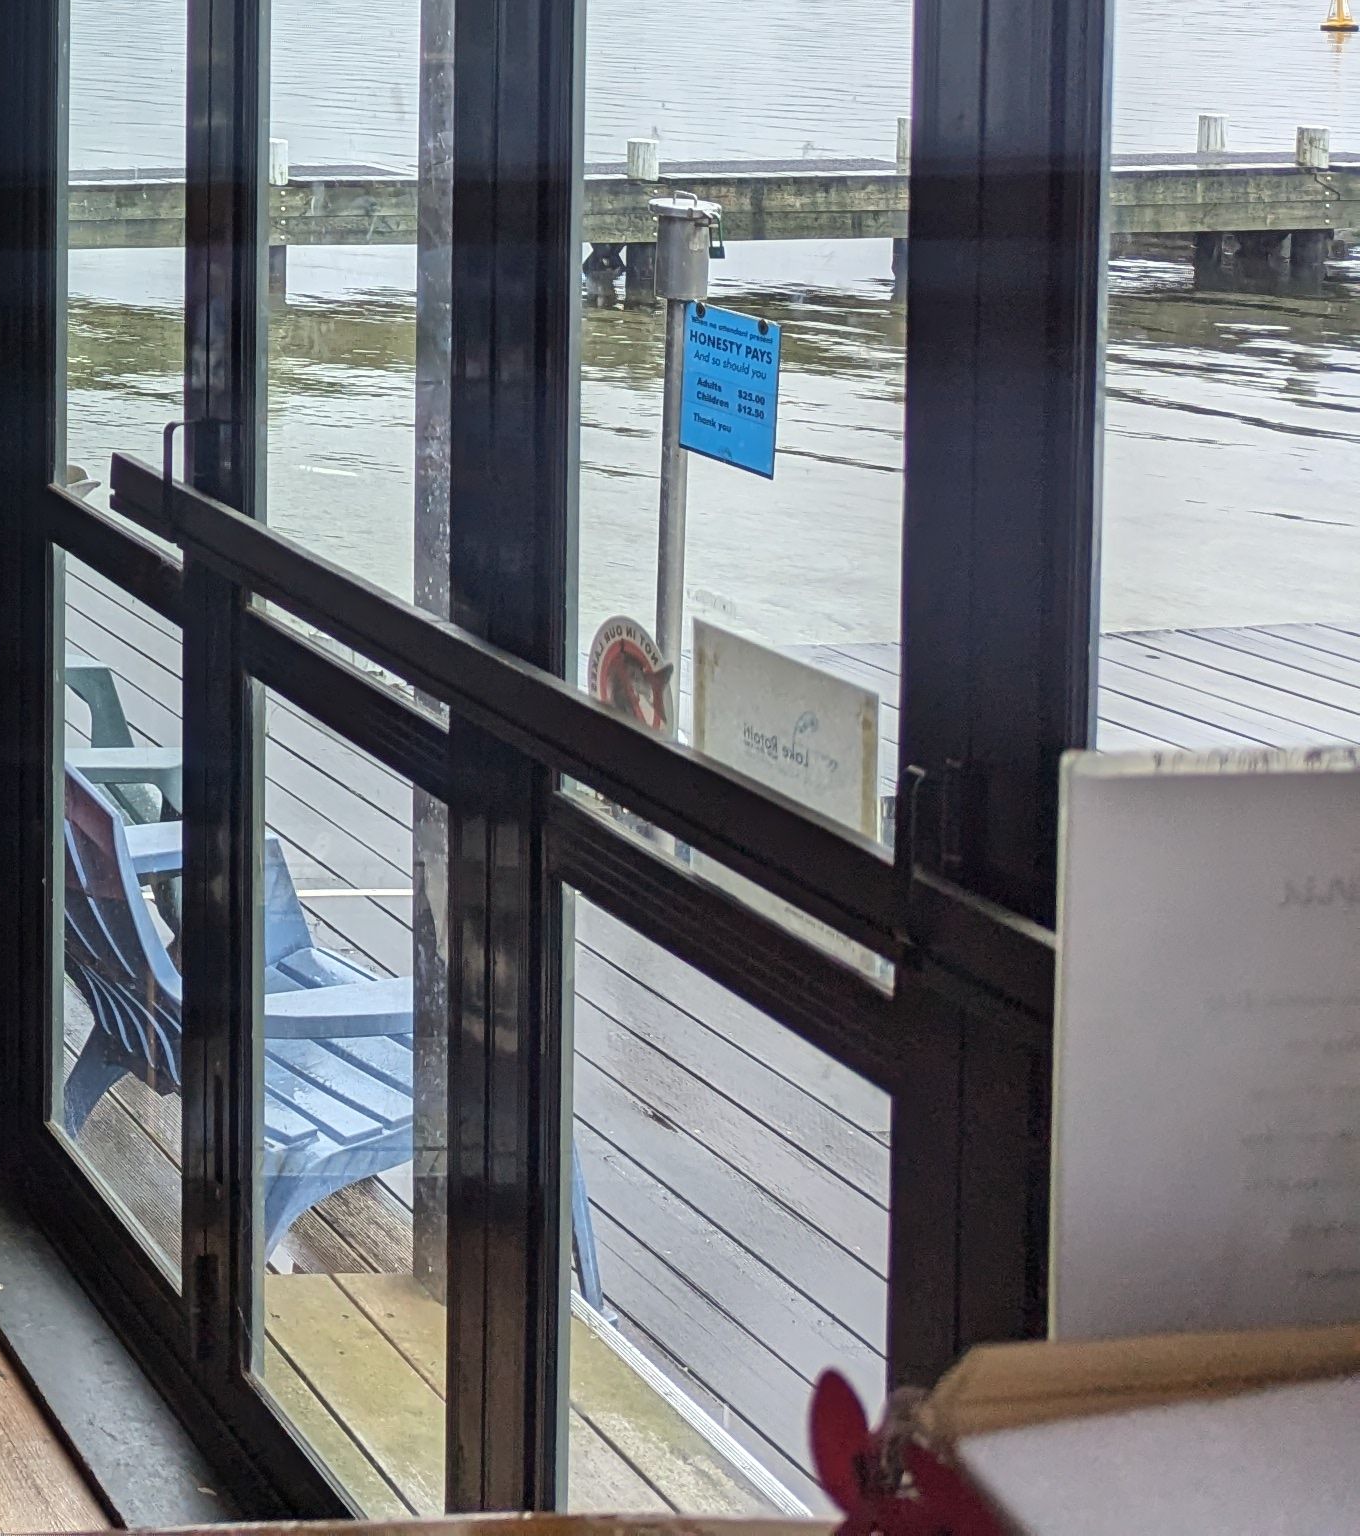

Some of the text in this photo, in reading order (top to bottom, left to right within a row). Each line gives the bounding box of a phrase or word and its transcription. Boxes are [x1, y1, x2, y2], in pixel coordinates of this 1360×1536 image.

[690, 330, 773, 364] HONESTY PAYS
[694, 350, 767, 380] And so should you
[697, 377, 722, 392] Adults
[697, 391, 729, 408] Children
[693, 412, 732, 433] Thank you
